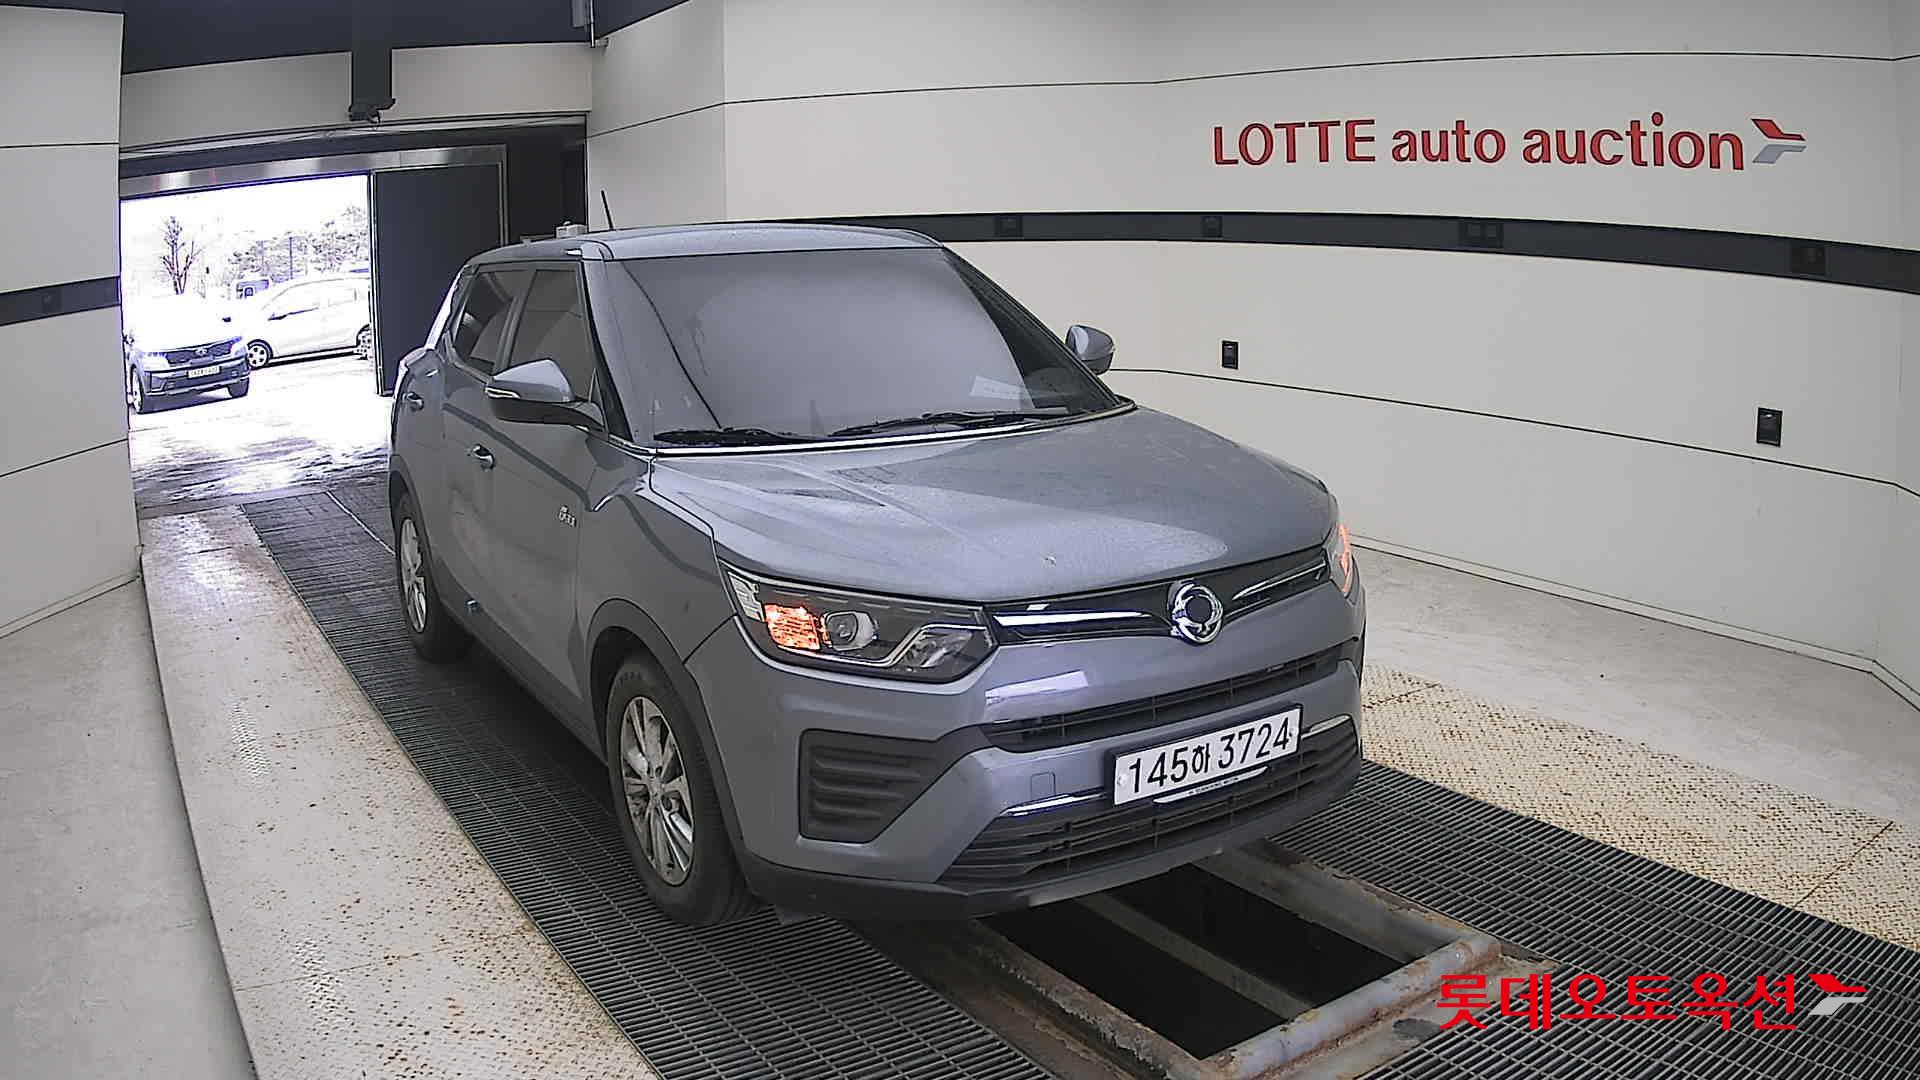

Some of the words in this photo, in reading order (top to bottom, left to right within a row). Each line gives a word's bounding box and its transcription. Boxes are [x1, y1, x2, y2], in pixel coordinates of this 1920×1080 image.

[1214, 119, 1375, 166] LOTTE
[1392, 120, 1506, 164] auto
[1523, 112, 1745, 170] auction
[1129, 743, 1210, 793] 145하
[1218, 717, 1289, 769] 3724
